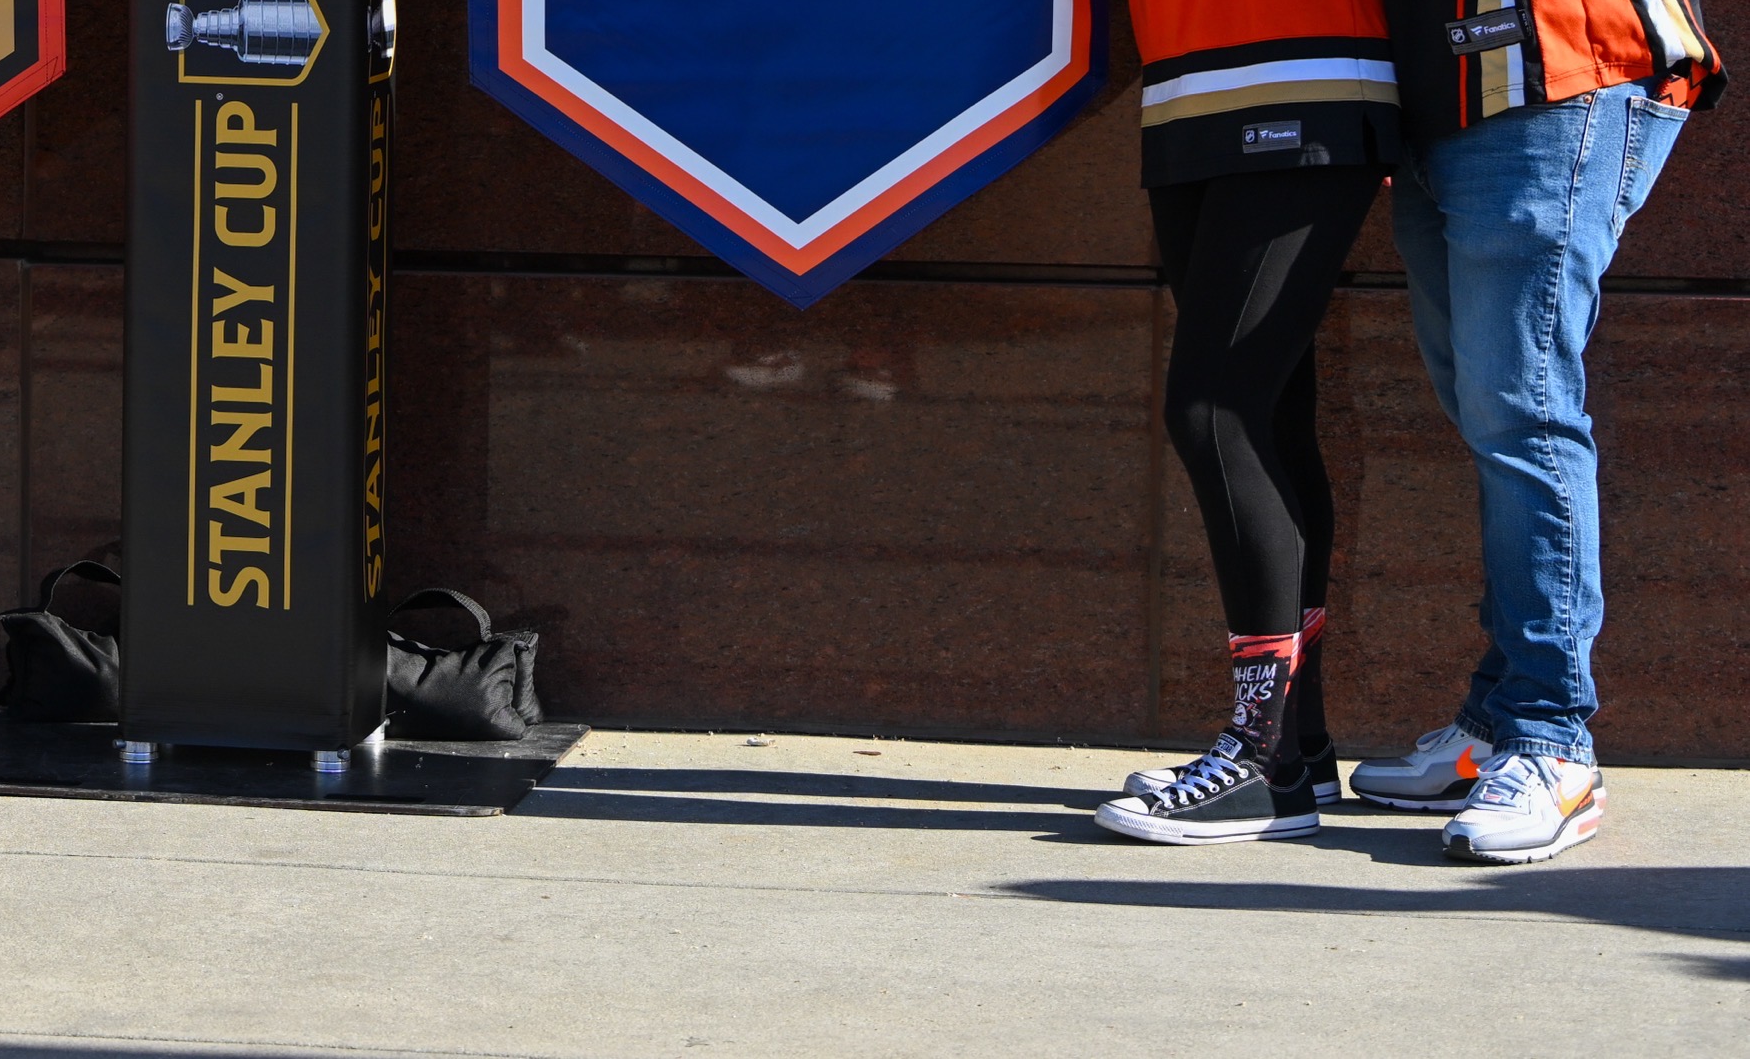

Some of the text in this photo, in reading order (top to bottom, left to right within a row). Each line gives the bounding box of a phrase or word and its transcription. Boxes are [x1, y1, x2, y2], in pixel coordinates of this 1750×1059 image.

[1269, 130, 1297, 139] Fanatics
[1484, 21, 1516, 35] Fanatics
[208, 100, 278, 610] STANLEY CUP
[366, 100, 385, 600] STANLEY CUP
